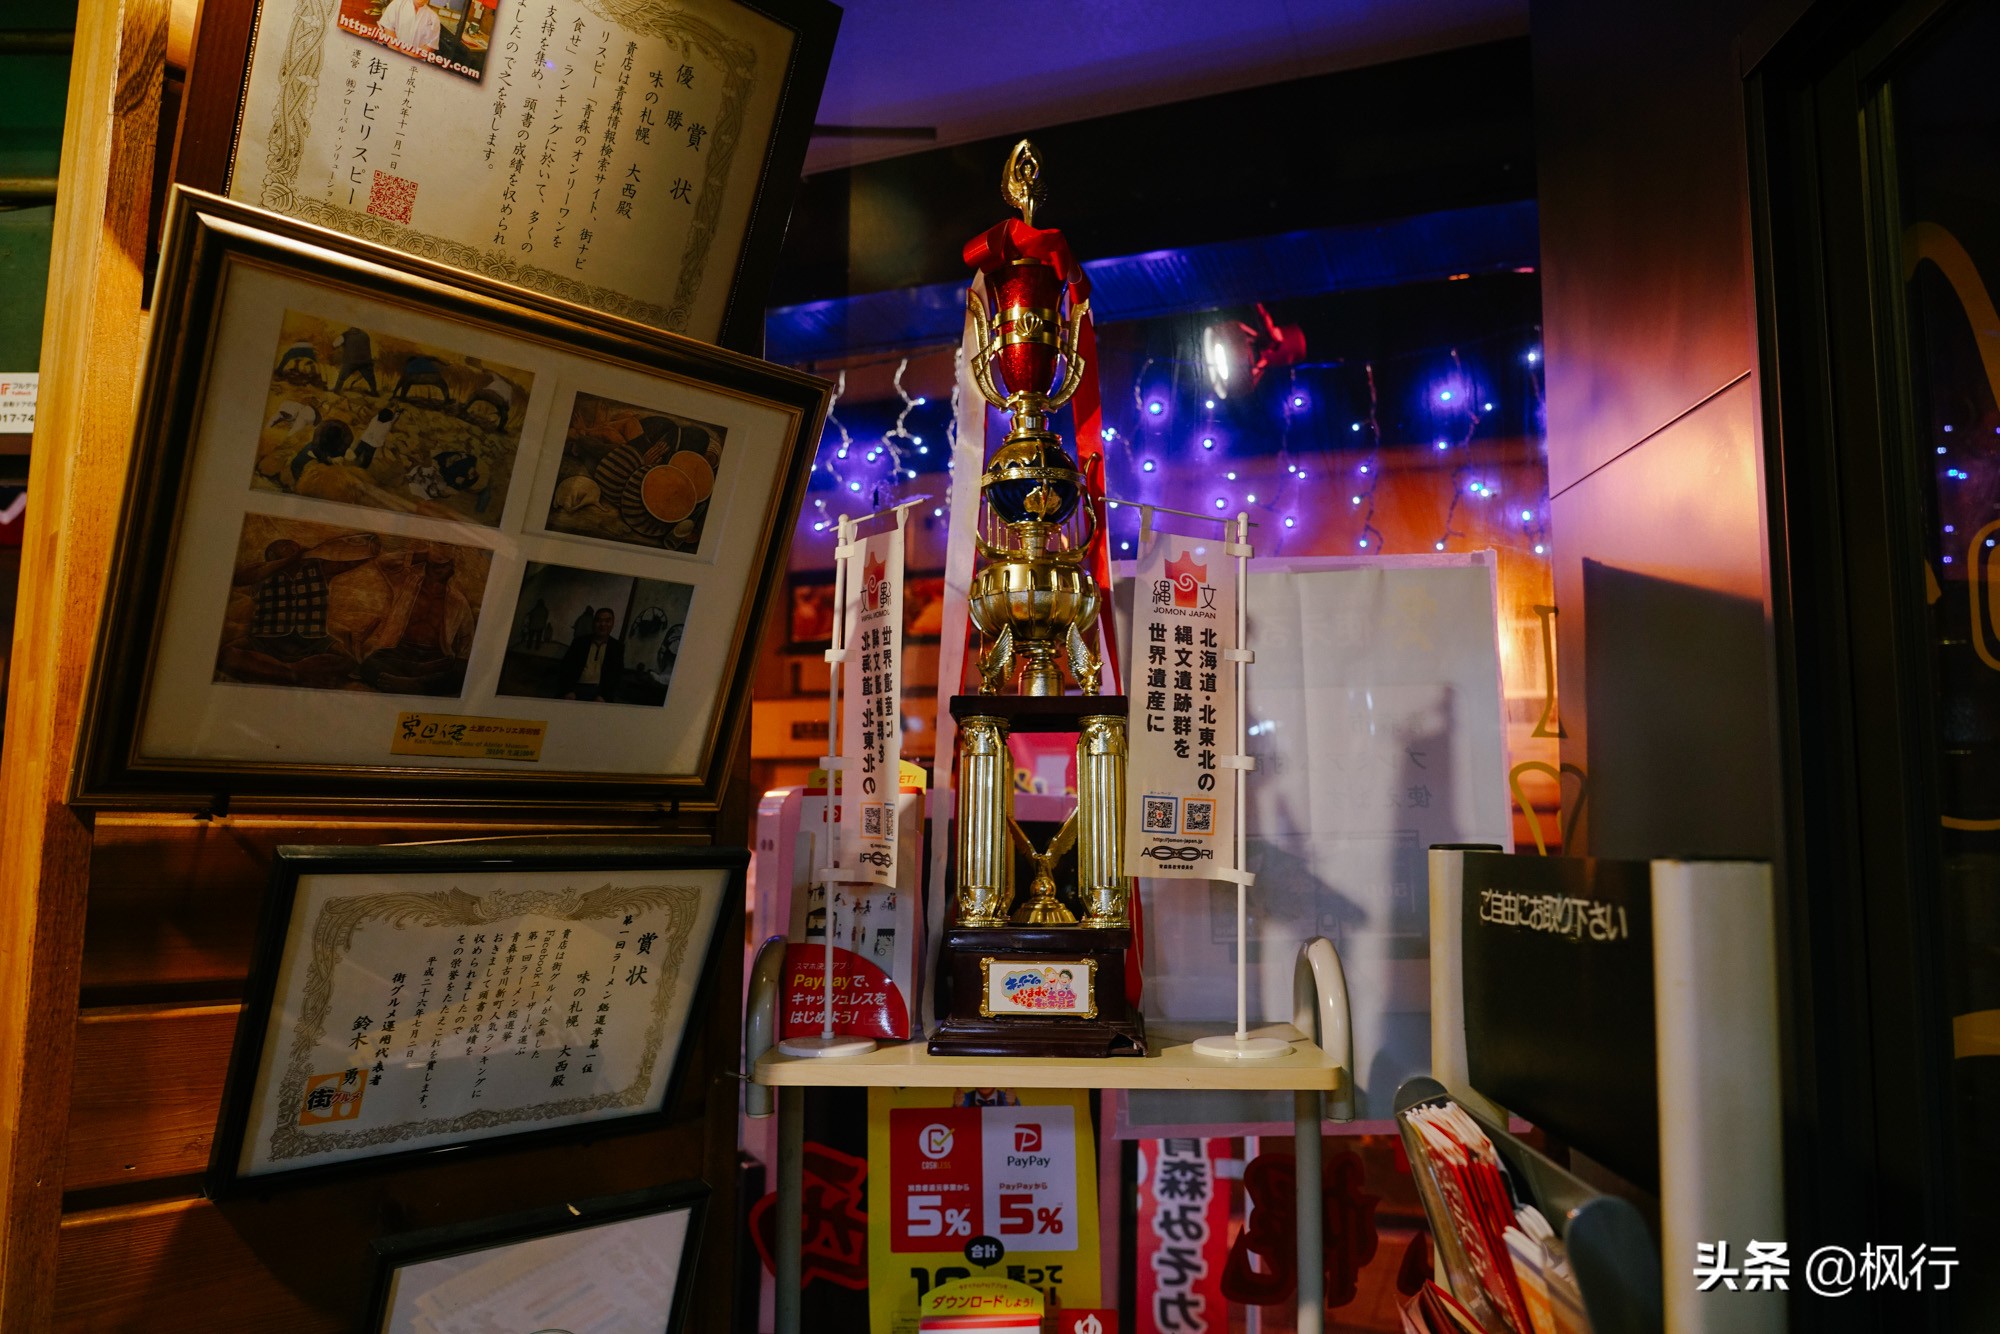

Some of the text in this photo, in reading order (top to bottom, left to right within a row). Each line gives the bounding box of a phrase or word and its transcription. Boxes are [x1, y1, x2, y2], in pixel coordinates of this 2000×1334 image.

[338, 12, 481, 80] http://www.rspey.com
[389, 65, 420, 170] 平成十九年十一月一日
[663, 63, 694, 133] 優勝
[348, 56, 388, 206] 街ナビリスピー
[615, 70, 665, 220] 味の札幌 大西殿
[669, 123, 706, 204] 賞状
[1153, 606, 1216, 619] JOMON JAPAN
[1147, 623, 1168, 732] 世界遺産に
[1173, 625, 1194, 759] 縄文遺跡群を
[1198, 628, 1217, 792] 北海道・北東北の
[1480, 888, 1629, 941] ご自由にお取り下さい
[624, 932, 658, 986] 賞状
[793, 974, 870, 990] Payayで、
[794, 961, 852, 971] スマホ決アプリ
[348, 1015, 374, 1049] 鈴木
[550, 971, 591, 1088] 味の札幌 大西殿
[999, 1182, 1048, 1190] PayPayから
[1007, 1155, 1051, 1168] PayPay
[907, 1194, 972, 1237] 5%
[1000, 1194, 1064, 1235] 5%
[970, 1244, 998, 1259] 合計
